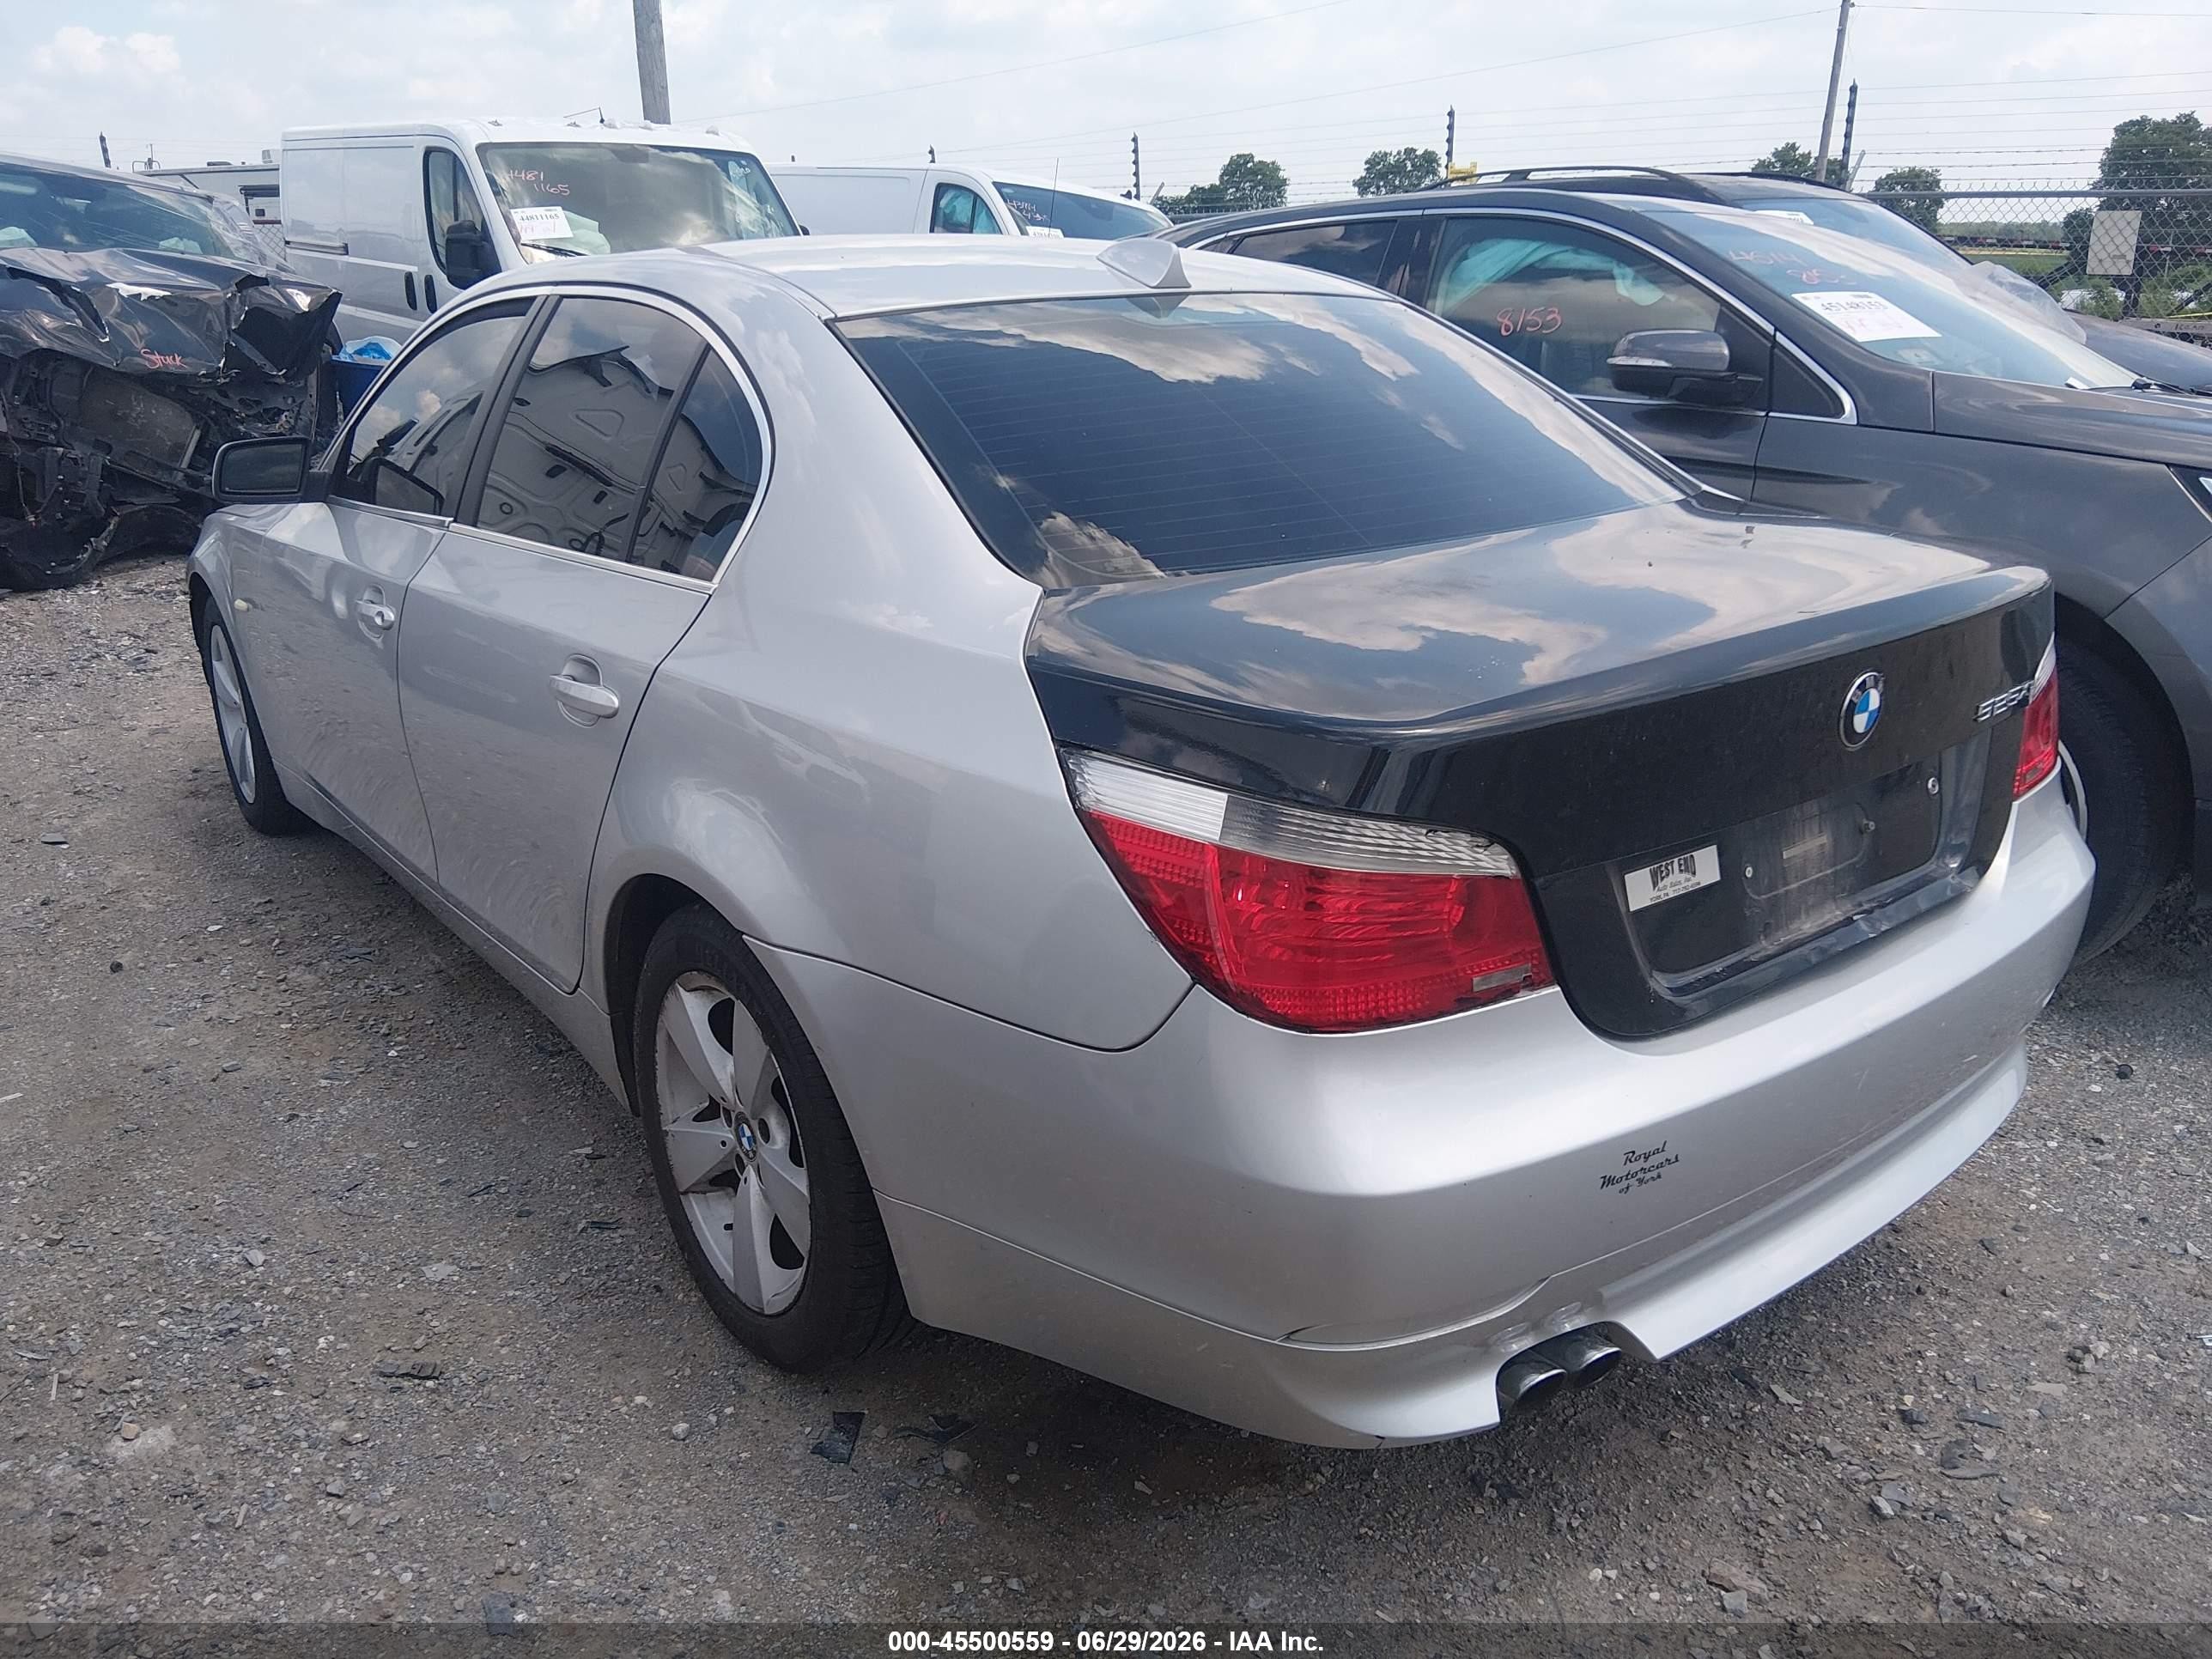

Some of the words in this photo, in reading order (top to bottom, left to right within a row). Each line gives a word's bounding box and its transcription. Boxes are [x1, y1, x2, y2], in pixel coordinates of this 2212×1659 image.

[534, 183, 570, 196] 1165
[519, 213, 561, 222] 44811165
[1497, 307, 1562, 337] 8153
[140, 349, 188, 369] Stuck
[1649, 860, 1675, 891] WEST
[1623, 1139, 1668, 1166] Royal
[1600, 1153, 1680, 1190] Motorcars
[1618, 1182, 1633, 1194] of
[1636, 1171, 1662, 1188] York
